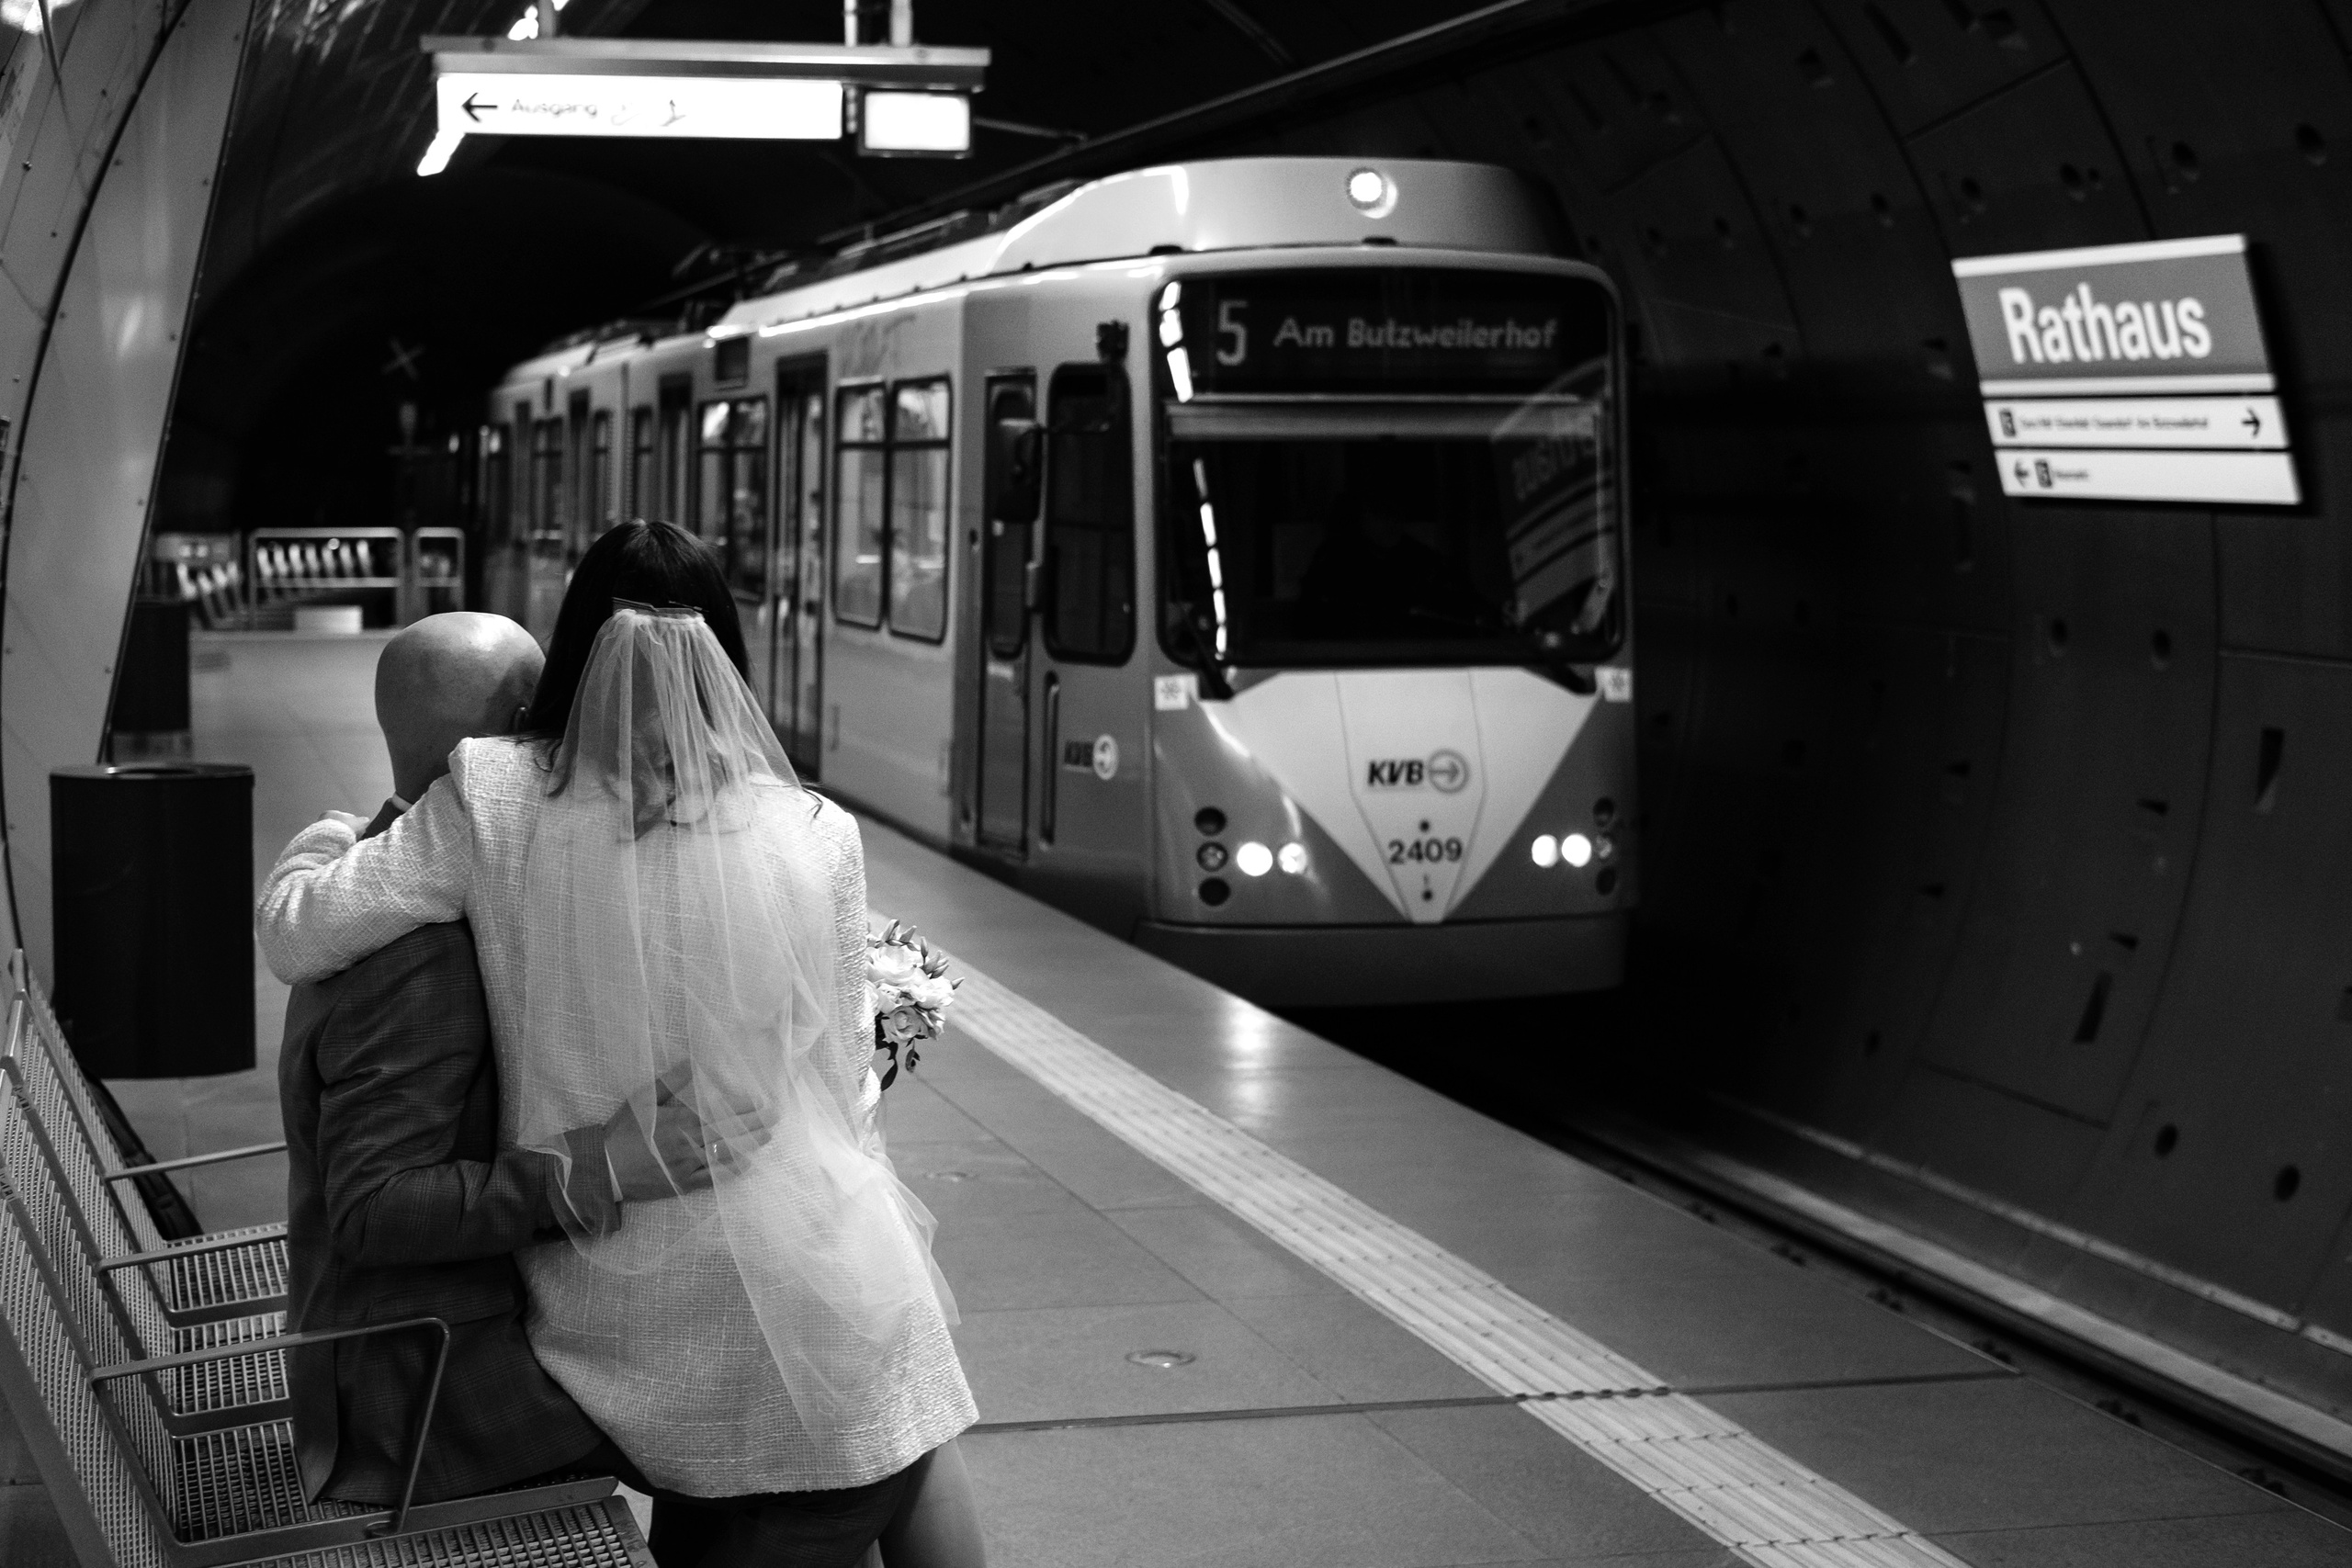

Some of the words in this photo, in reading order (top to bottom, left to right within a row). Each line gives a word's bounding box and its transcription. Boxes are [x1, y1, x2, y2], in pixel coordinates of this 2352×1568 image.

[1216, 300, 1249, 367] 5
[1272, 317, 1335, 348] Am
[1346, 317, 1557, 348] Butzweilerhof
[1998, 282, 2212, 364] Rathaus
[1367, 759, 1424, 786] KVB
[1388, 837, 1463, 864] 2409
